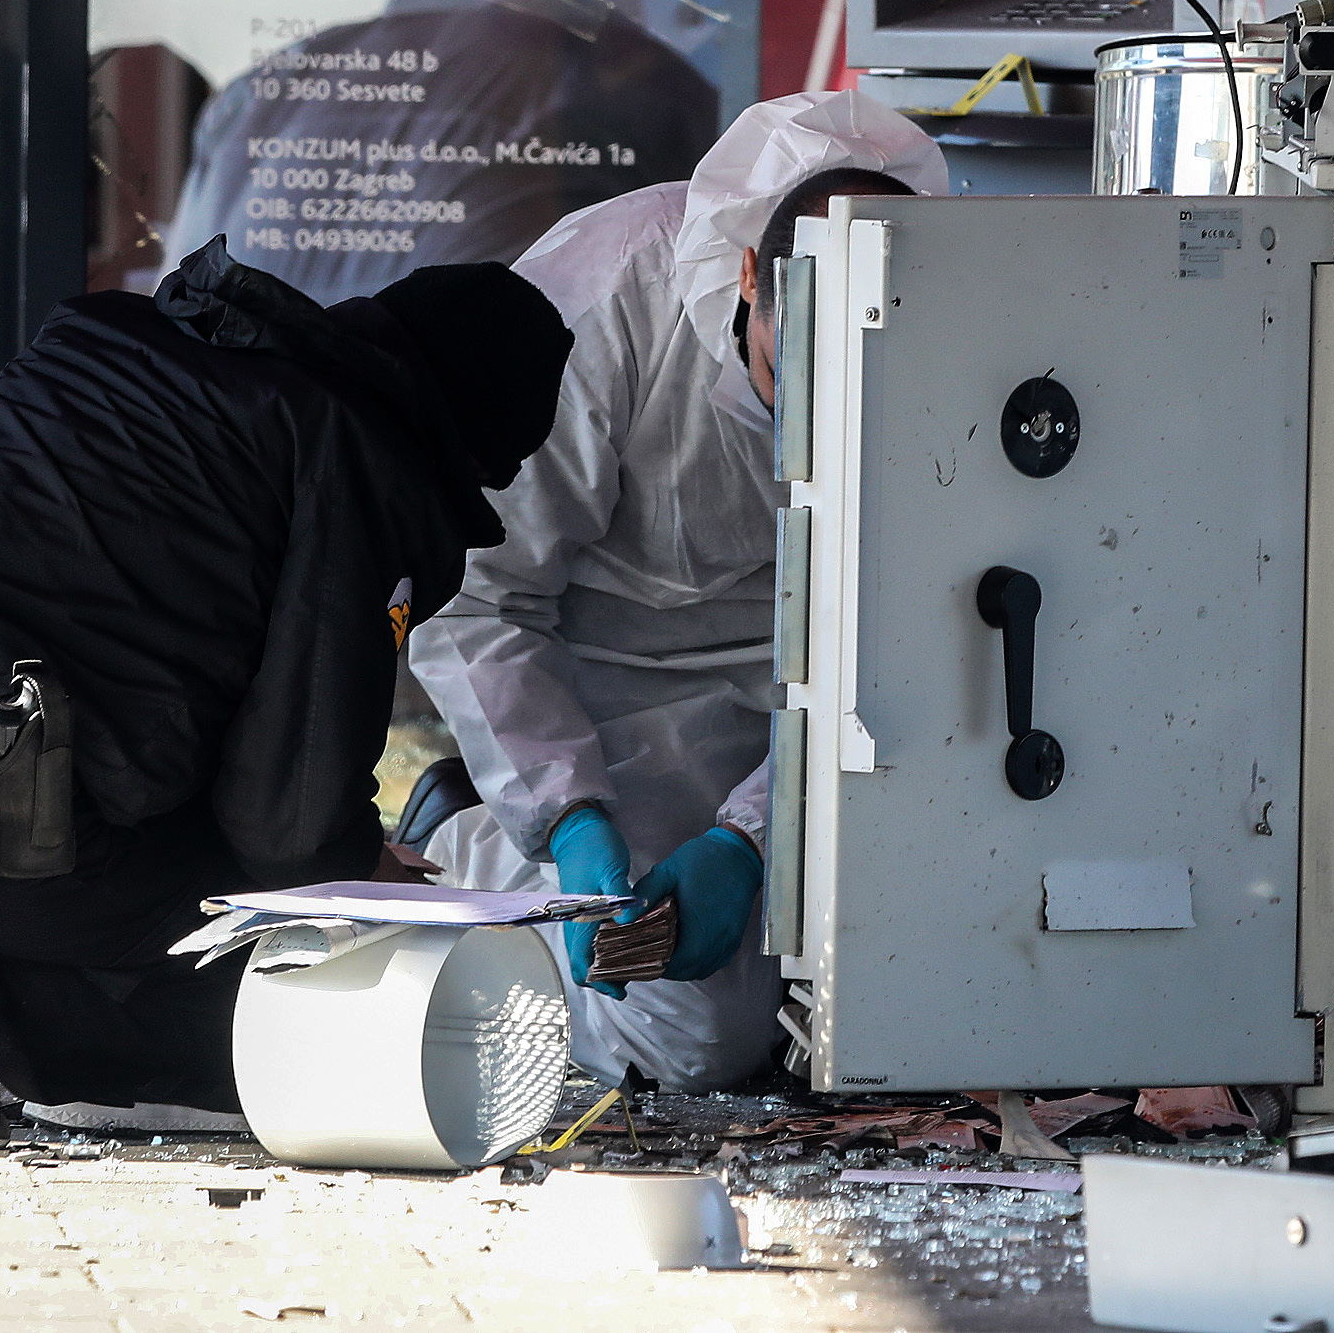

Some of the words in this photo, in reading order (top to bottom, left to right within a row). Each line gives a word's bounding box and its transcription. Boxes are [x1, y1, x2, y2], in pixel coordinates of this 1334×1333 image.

[386, 49, 418, 73] 48
[421, 48, 440, 73] b
[252, 77, 280, 100] 10
[286, 77, 331, 101] 360
[335, 78, 427, 103] Sesvete
[247, 137, 361, 160] KONZUM
[366, 138, 415, 166] plus
[608, 143, 636, 166] 1a
[251, 169, 279, 189] 10
[282, 169, 329, 190] 000
[334, 169, 415, 195] Zagreb
[246, 197, 295, 220] OIB:
[300, 198, 466, 224] 62226620908
[246, 228, 290, 251] MB:
[294, 228, 415, 254] 04939026
